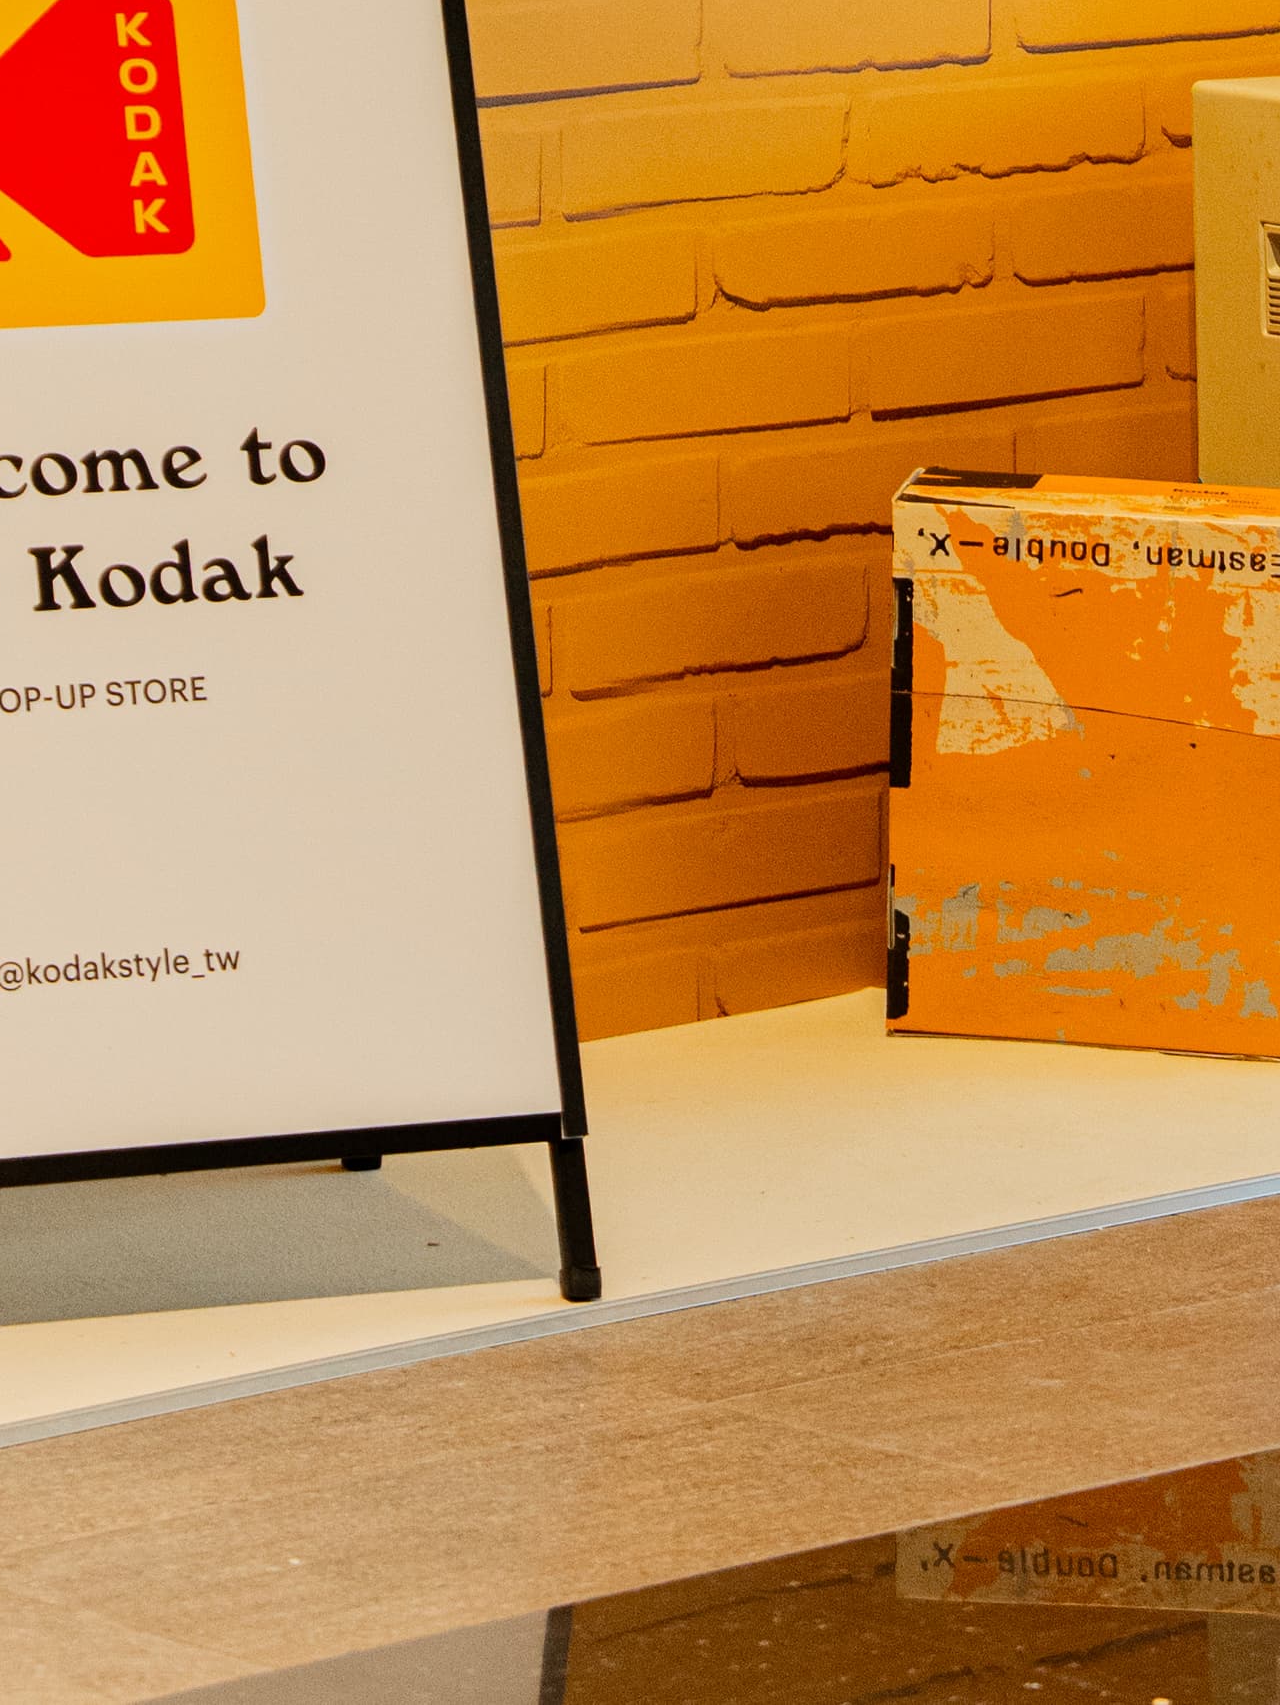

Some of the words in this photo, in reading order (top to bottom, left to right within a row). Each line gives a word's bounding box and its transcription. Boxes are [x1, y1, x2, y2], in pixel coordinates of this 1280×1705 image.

[113, 10, 170, 236] KODAK
[240, 427, 328, 488] to
[29, 534, 304, 613] Kodak
[103, 675, 207, 709] STORE
